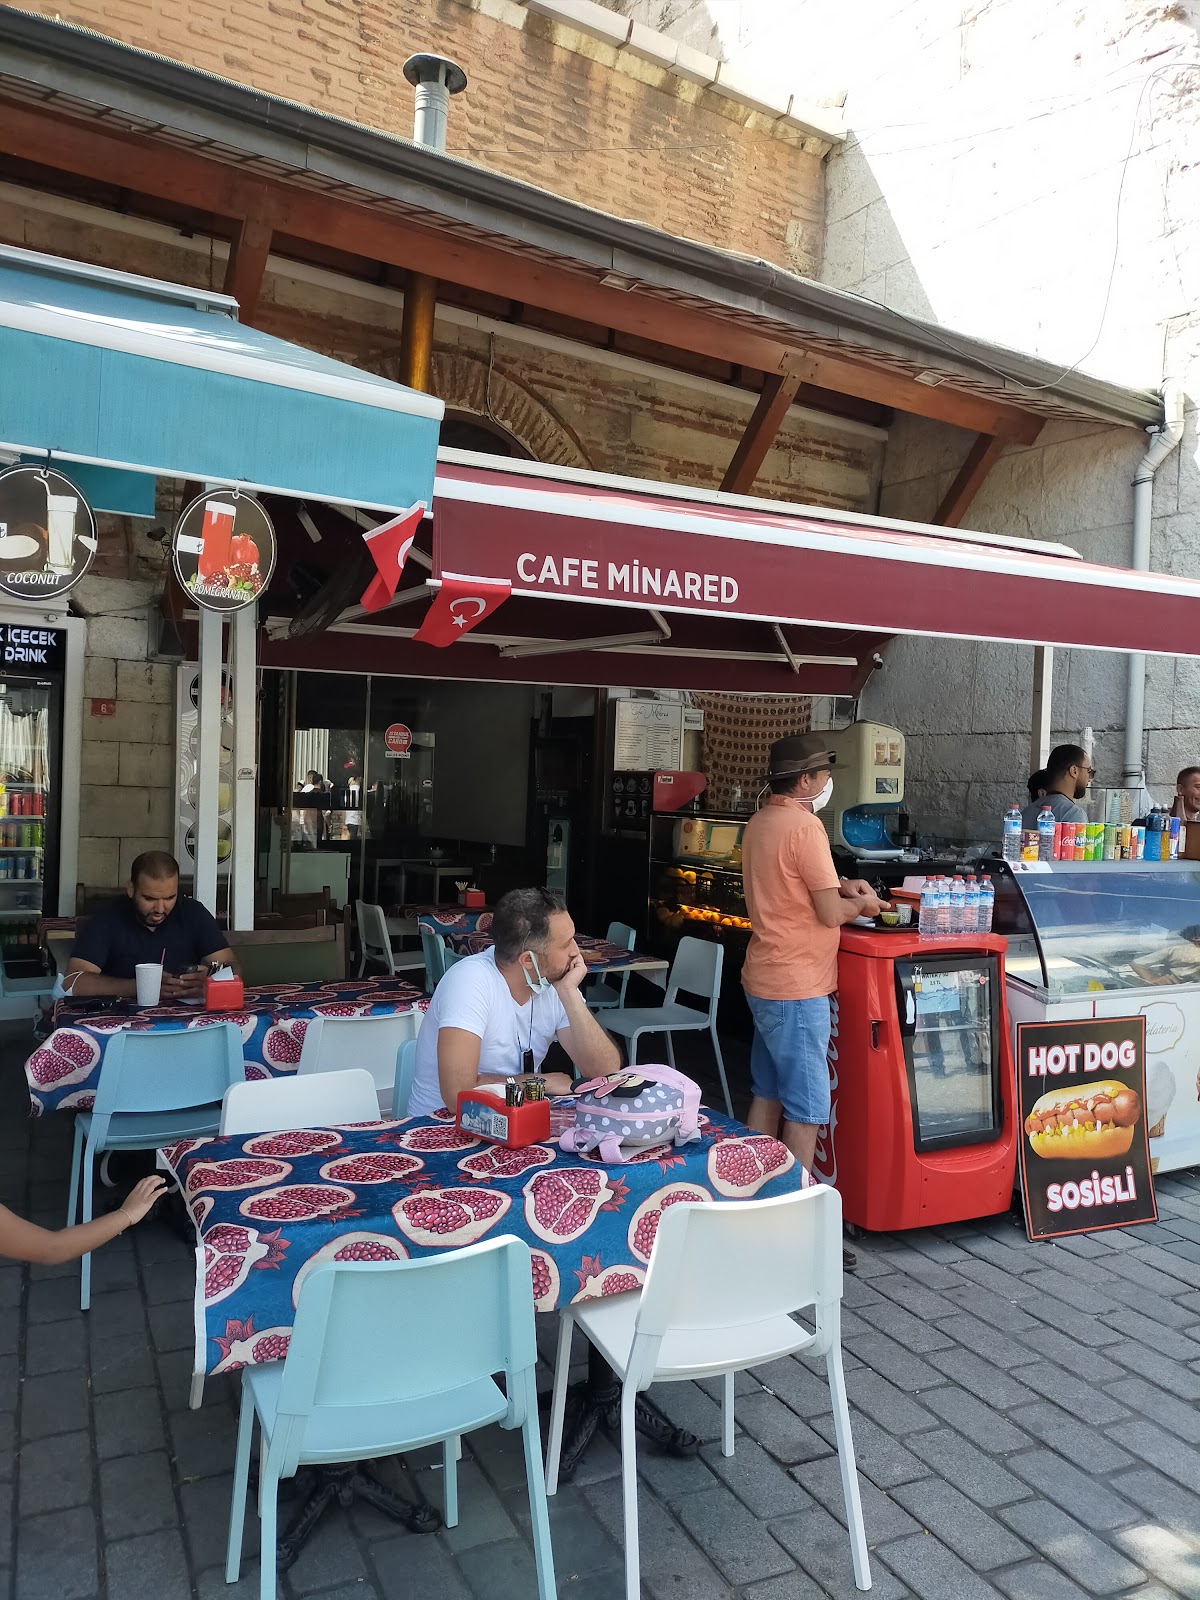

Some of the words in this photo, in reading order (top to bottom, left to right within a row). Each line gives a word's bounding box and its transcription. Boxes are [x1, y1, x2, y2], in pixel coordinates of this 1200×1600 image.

[6, 572, 62, 585] COCONUT
[516, 552, 599, 589] CAFE
[607, 559, 739, 604] MİNARED
[193, 583, 249, 601] POMEGRANATE
[7, 625, 57, 647] İÇECEK
[4, 646, 47, 664] DRINK
[100, 703, 107, 713] 6
[1028, 1043, 1081, 1076] HOT
[1084, 1040, 1136, 1072] DOG
[1047, 1165, 1137, 1213] SOSİSLİ
